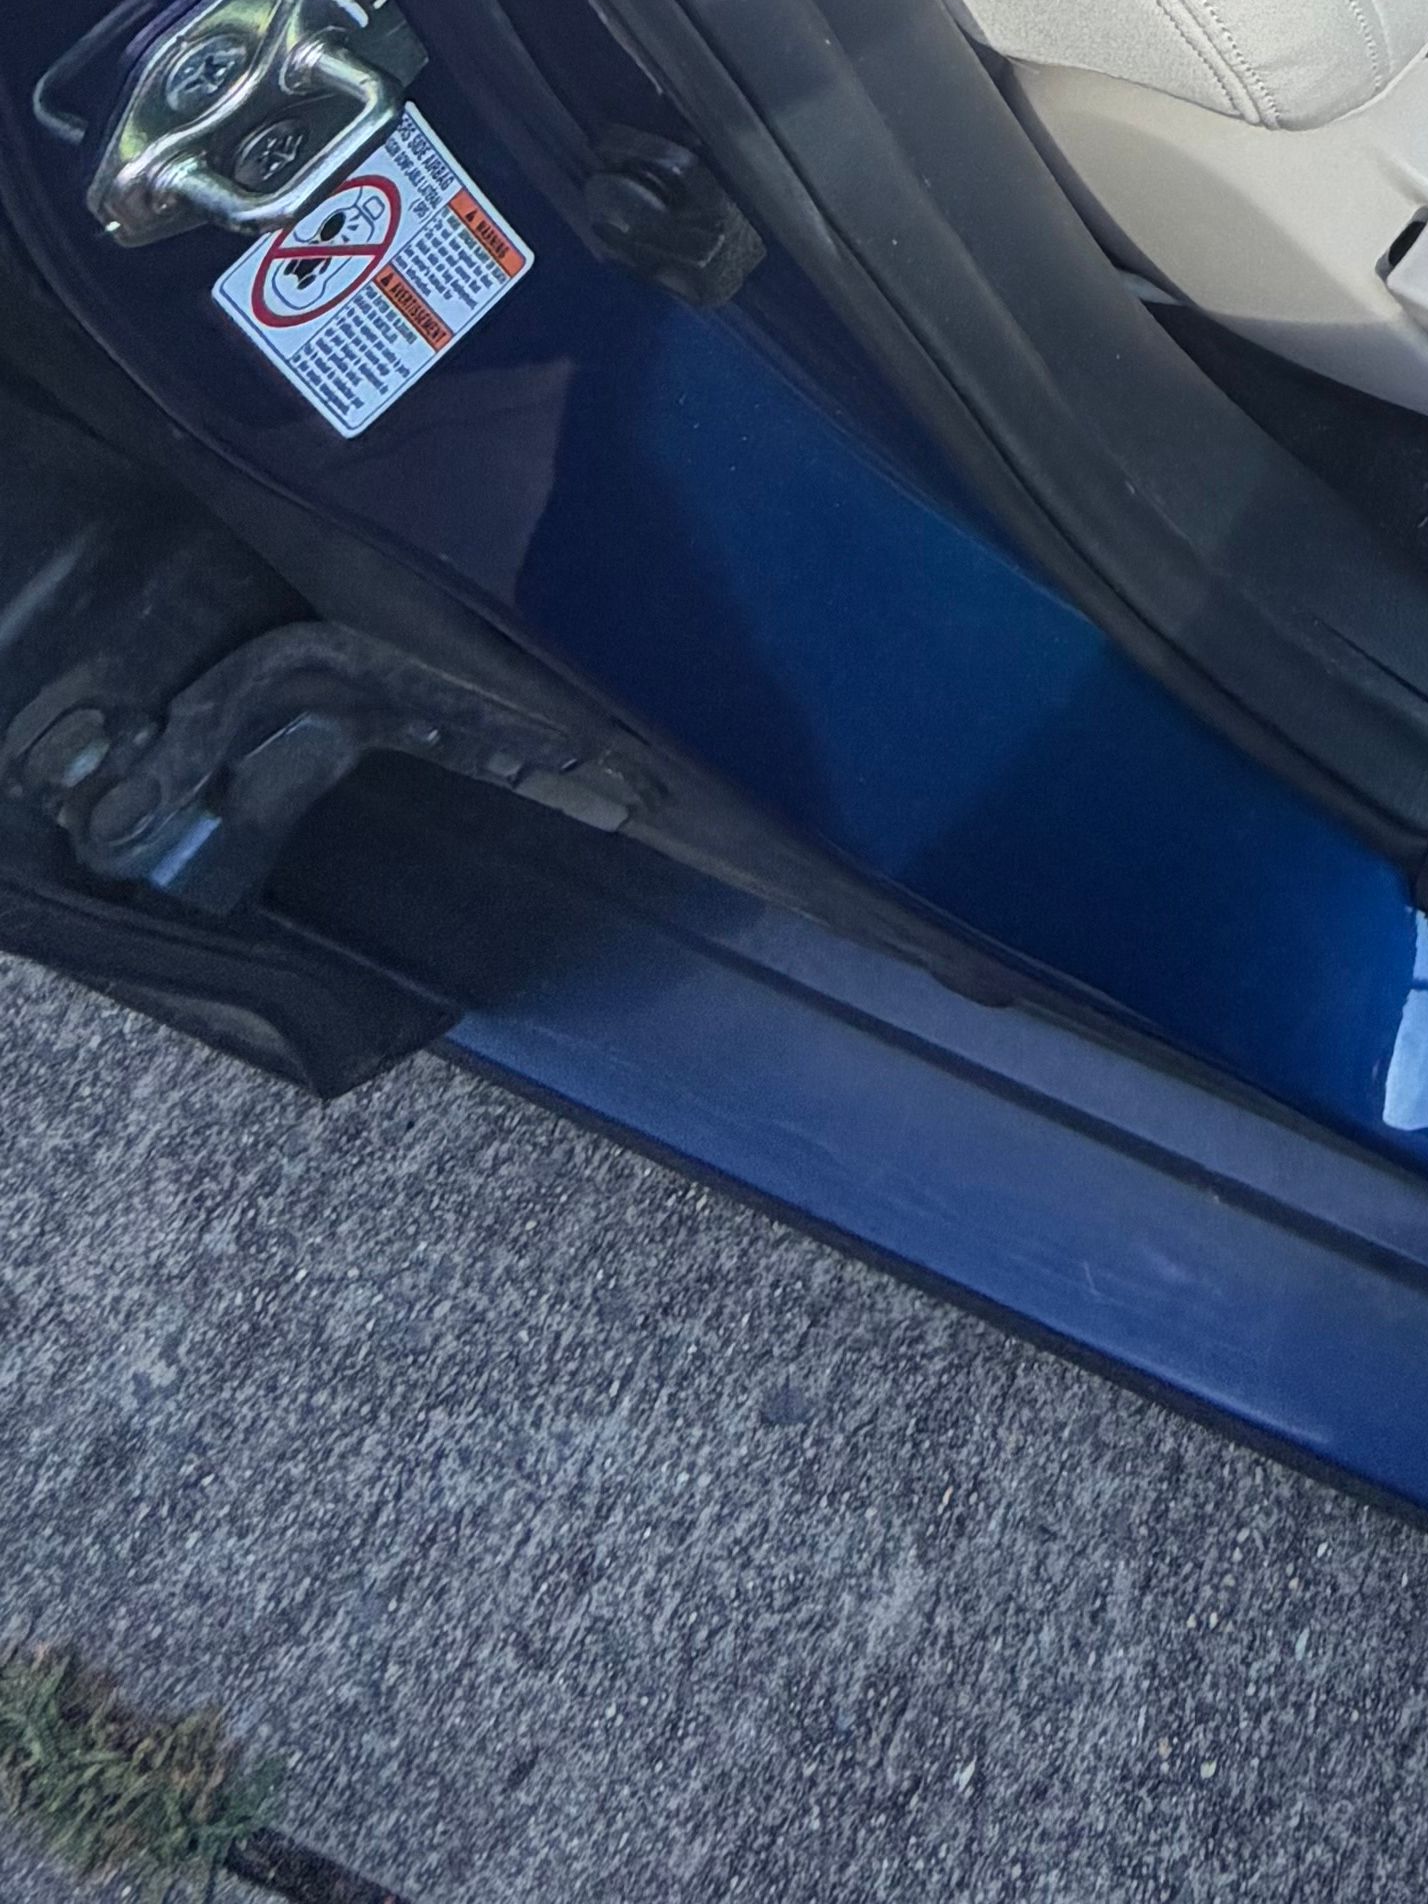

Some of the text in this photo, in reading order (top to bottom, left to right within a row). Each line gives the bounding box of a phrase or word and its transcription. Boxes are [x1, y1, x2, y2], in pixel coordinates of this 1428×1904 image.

[406, 134, 431, 160] SIDE
[422, 153, 454, 190] AIRBAG
[476, 220, 509, 258] WARNING
[390, 282, 447, 343] AVERTISSEMENT
